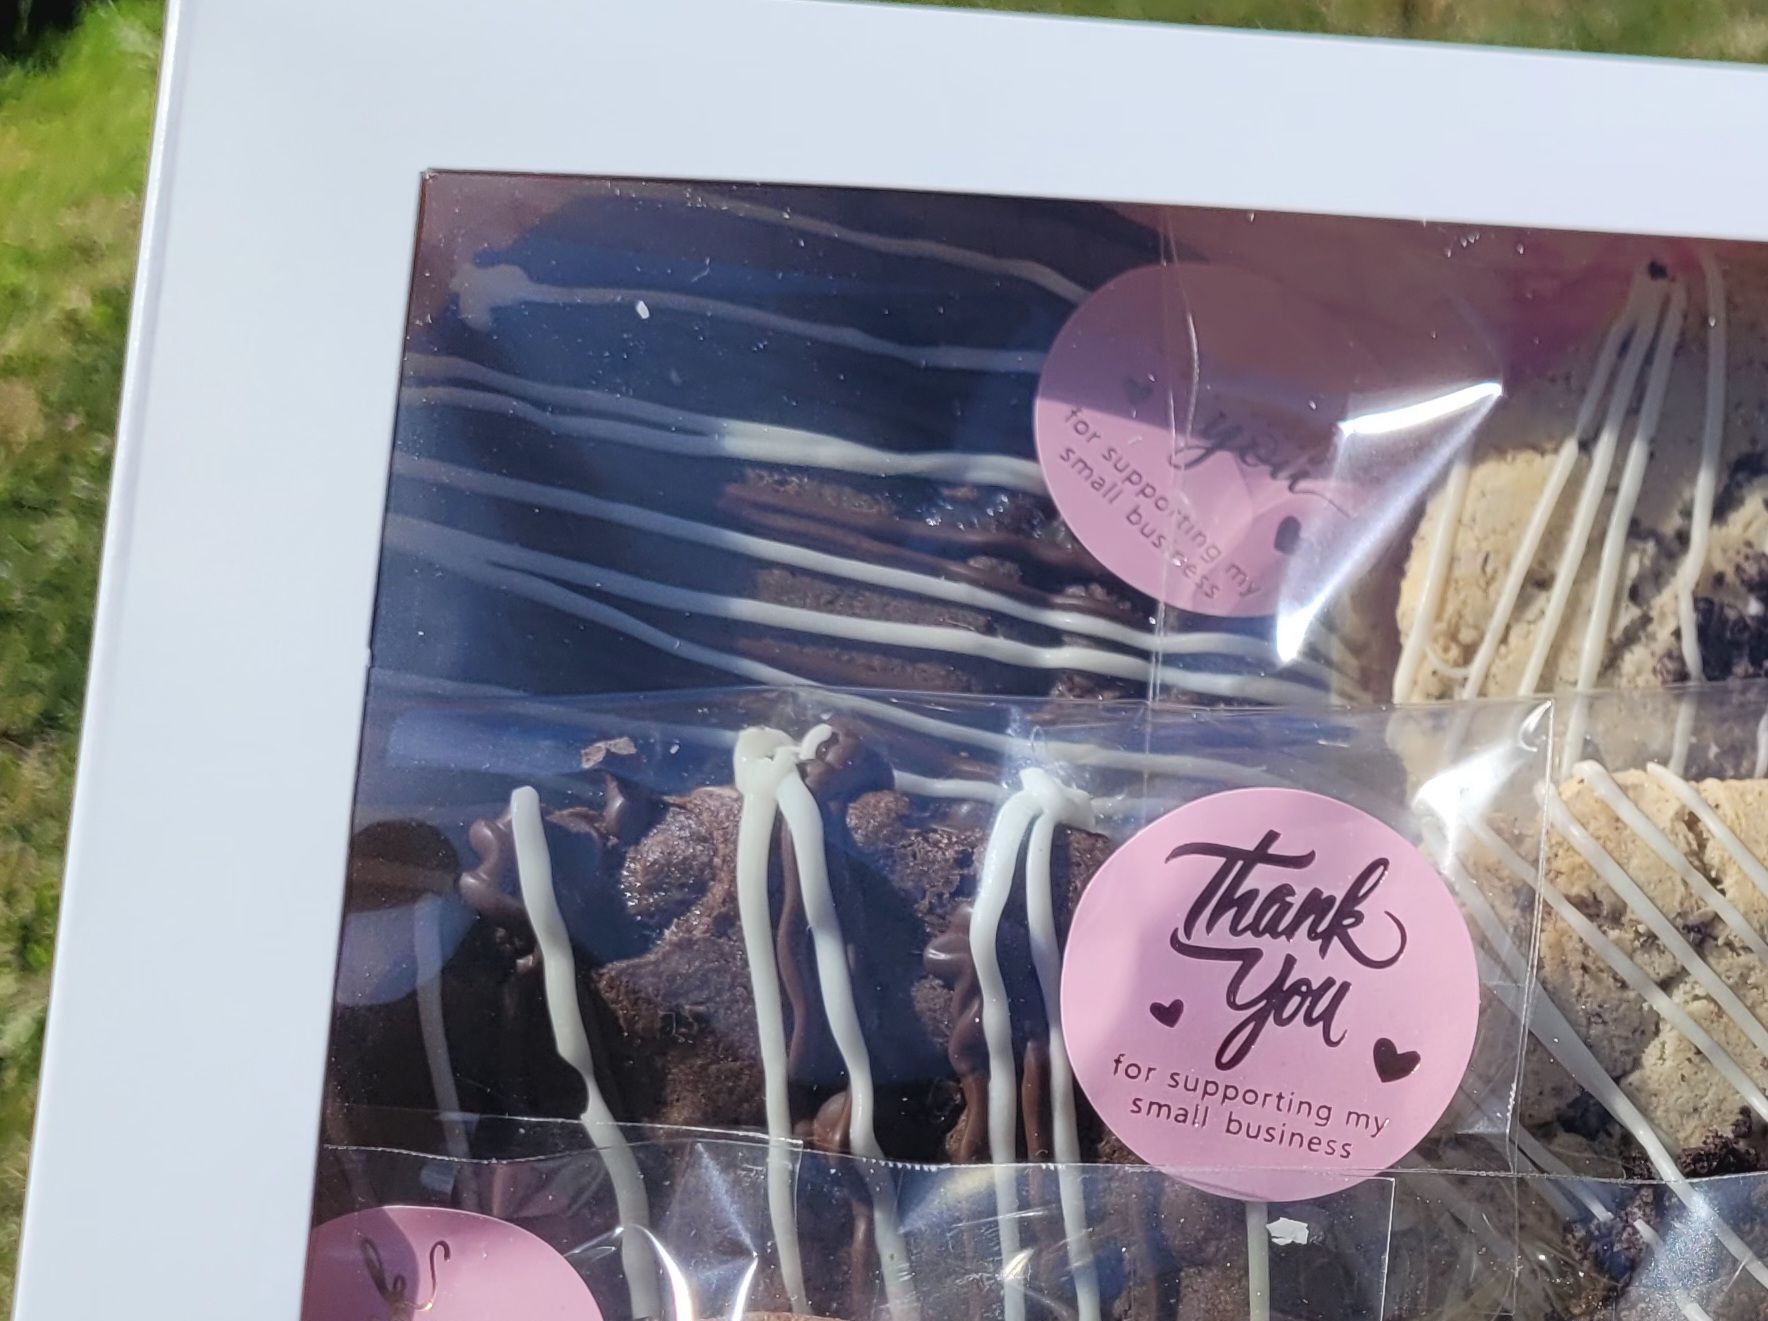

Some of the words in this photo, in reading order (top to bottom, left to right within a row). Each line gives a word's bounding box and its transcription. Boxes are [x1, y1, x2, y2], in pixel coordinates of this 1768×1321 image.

[1060, 448, 1123, 504] small
[1065, 407, 1101, 443] for
[1102, 447, 1221, 563] supporting
[1226, 563, 1260, 598] my
[1164, 830, 1407, 969] Thank
[1170, 928, 1352, 1071] You
[1113, 1053, 1157, 1084] for
[1167, 1070, 1333, 1127] supporting
[1346, 1108, 1390, 1139] my
[1130, 1096, 1209, 1129] small
[1225, 1111, 1353, 1160] business
